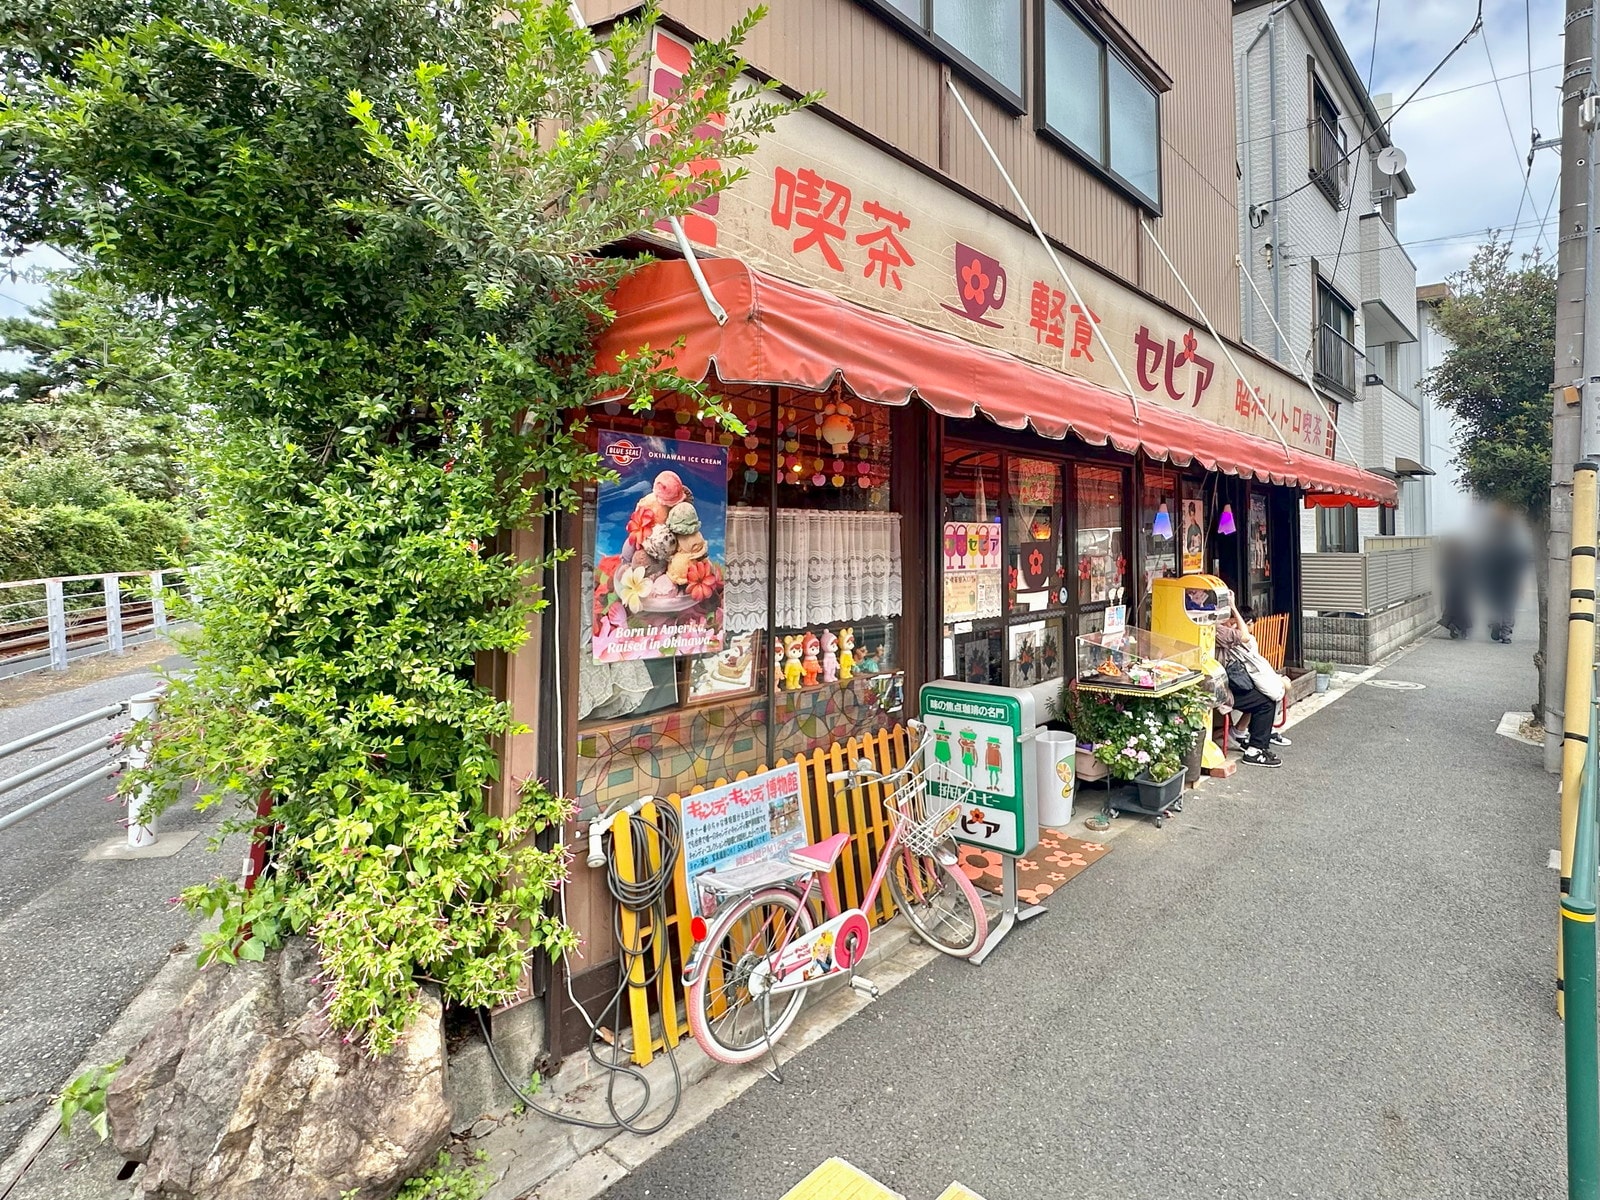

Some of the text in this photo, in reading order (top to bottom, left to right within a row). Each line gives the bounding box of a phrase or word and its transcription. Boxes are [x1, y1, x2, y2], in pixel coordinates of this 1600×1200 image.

[771, 166, 915, 291] 喫茶
[1030, 280, 1101, 363] 軽食
[1134, 325, 1215, 408] セピア
[608, 446, 640, 457] BLUE SEAL
[648, 451, 722, 466] OKINAWAN ICE CREAM
[615, 626, 645, 639] Born
[647, 624, 658, 636] in
[607, 636, 713, 654] Raised in Okinawa.
